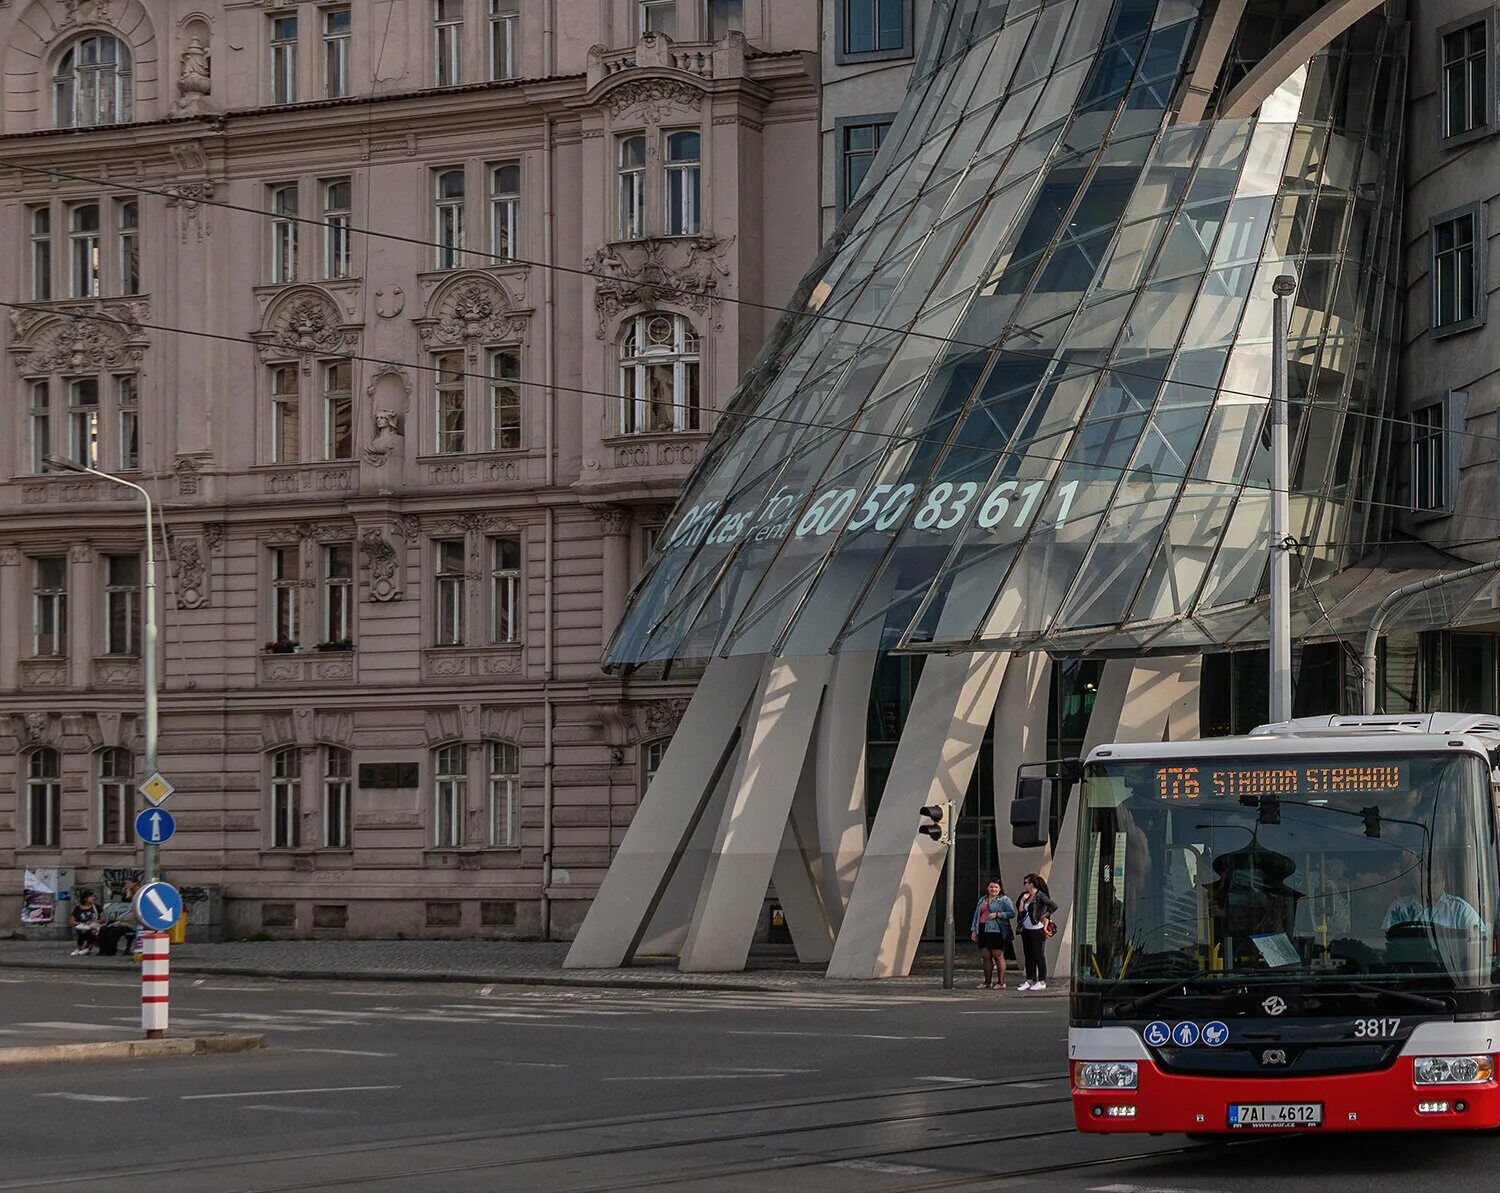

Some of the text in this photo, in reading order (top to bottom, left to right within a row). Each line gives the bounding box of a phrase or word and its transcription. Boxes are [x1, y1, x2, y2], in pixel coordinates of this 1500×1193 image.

[1156, 766, 1399, 798] 176 STADION STRAHOV
[1354, 1018, 1401, 1037] 3817
[1071, 1045, 1076, 1056] 7
[1486, 1038, 1493, 1049] 7
[1241, 1106, 1314, 1121] 7AI 4612
